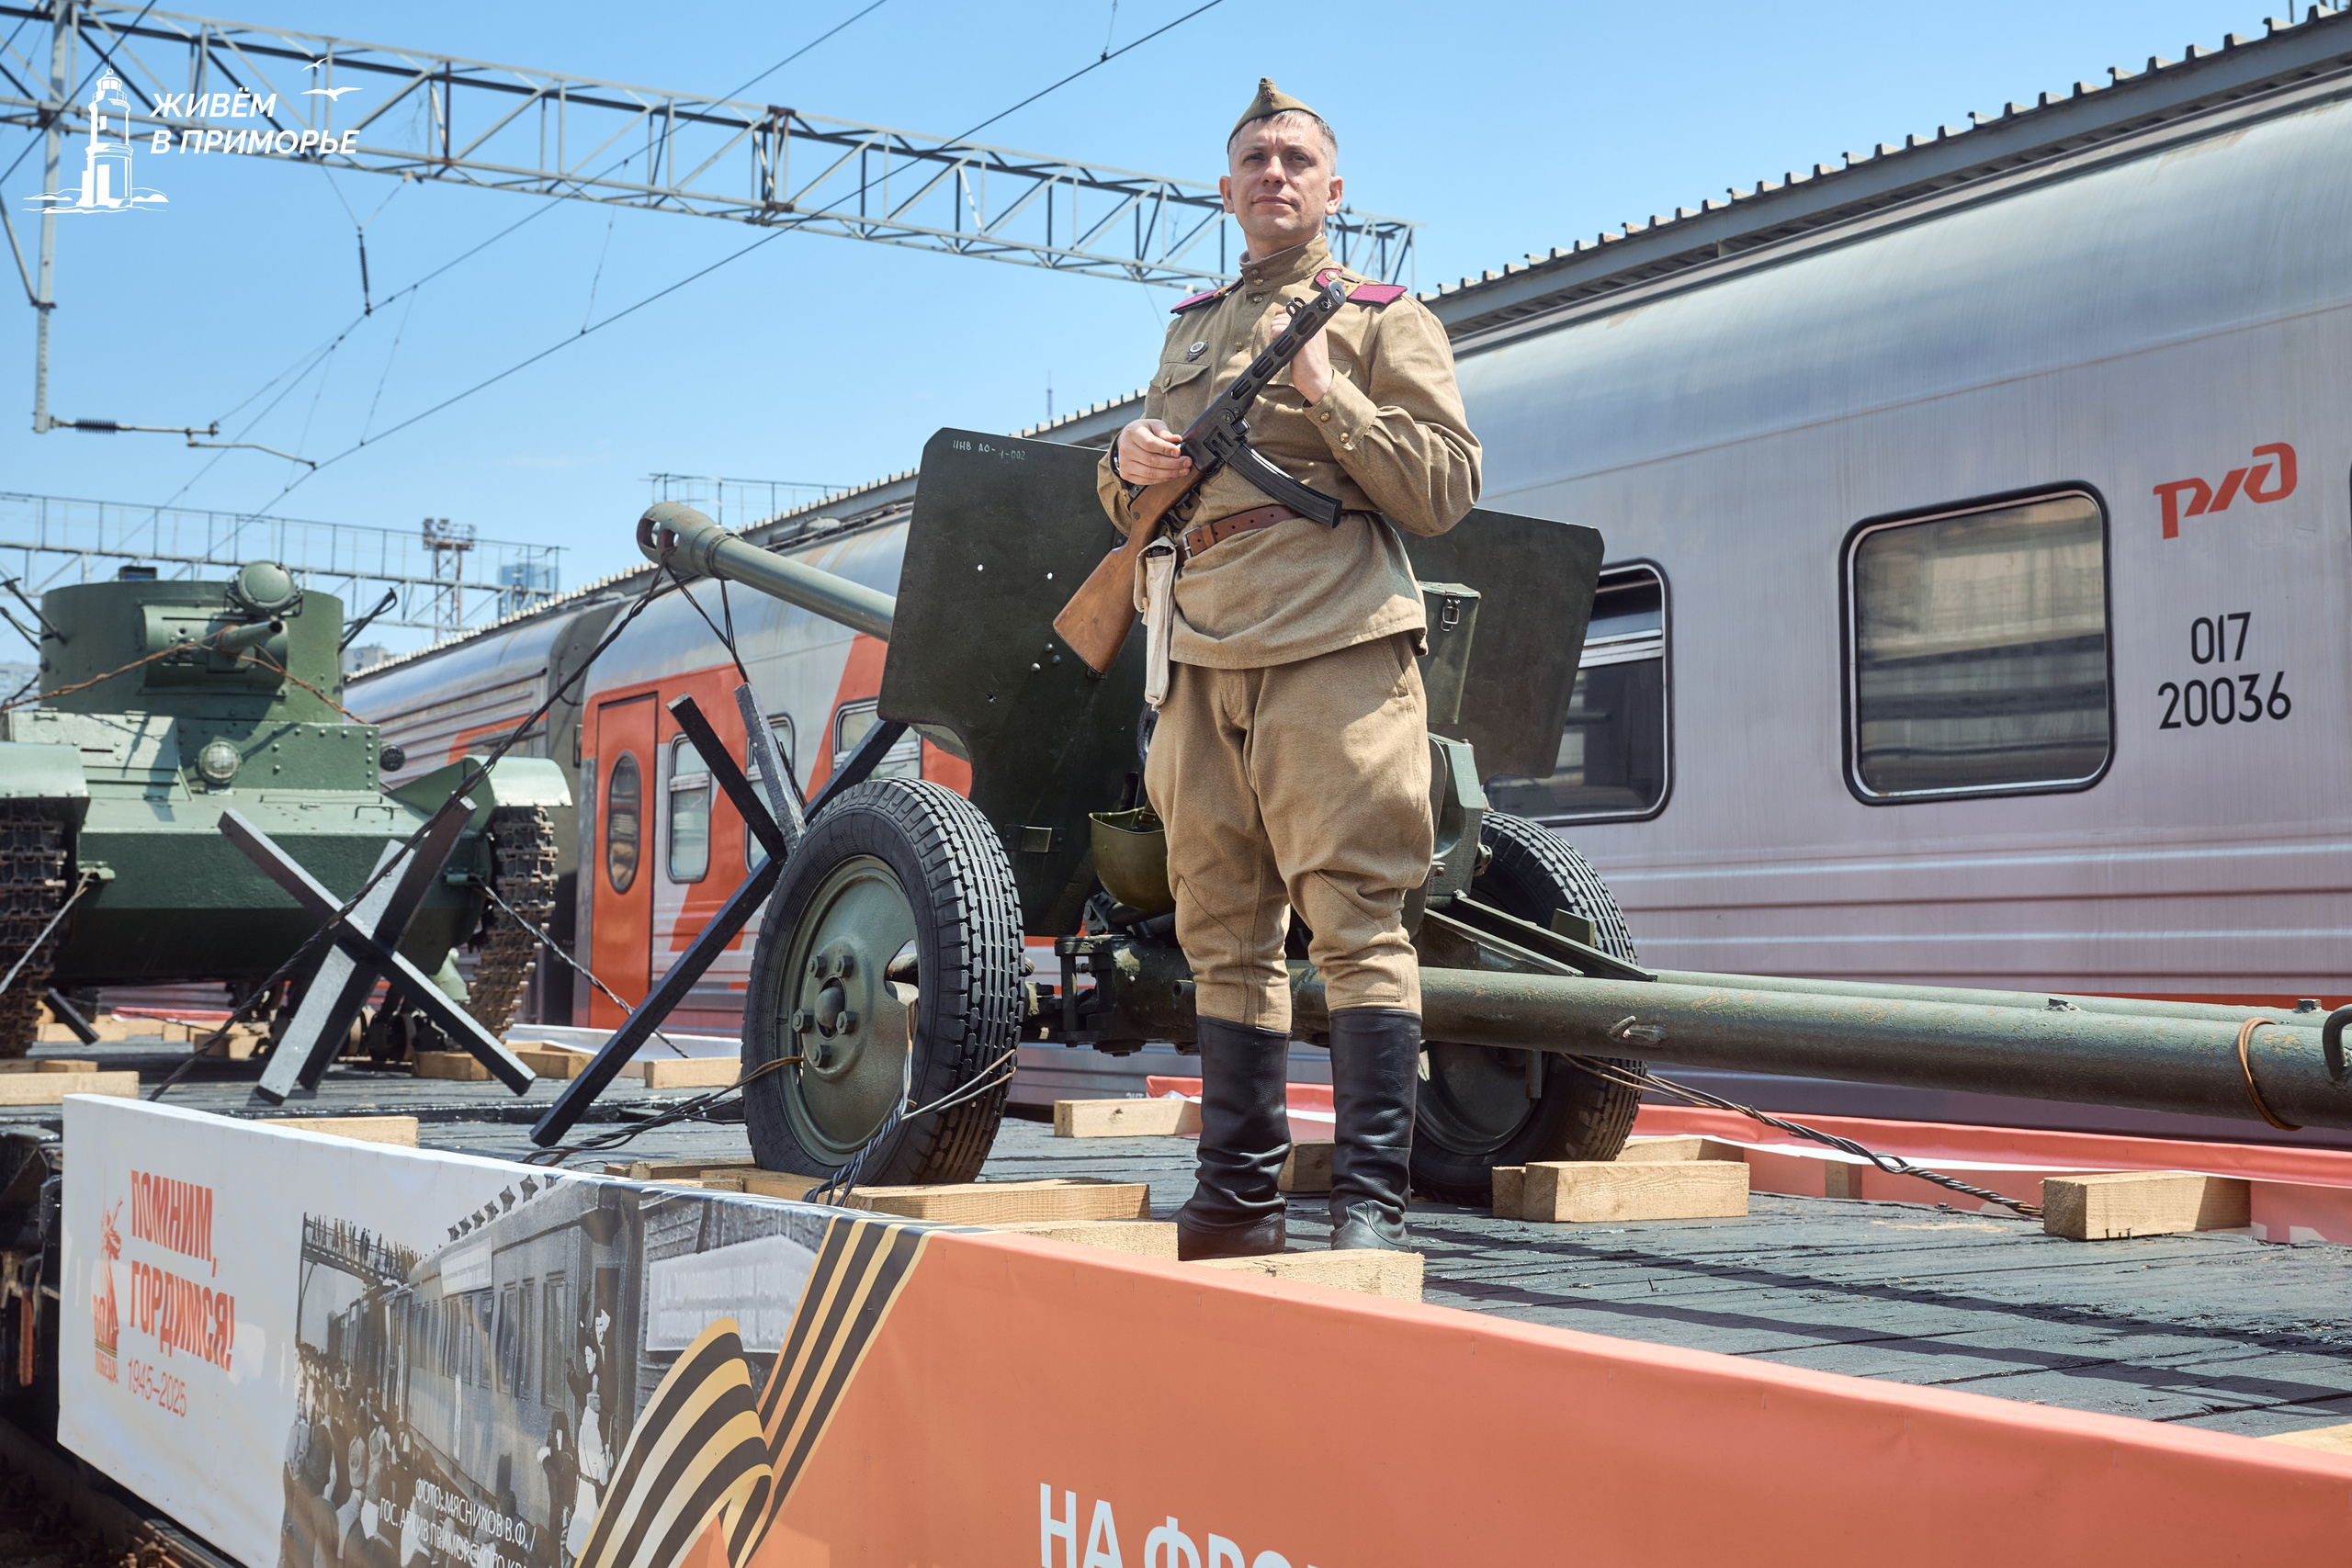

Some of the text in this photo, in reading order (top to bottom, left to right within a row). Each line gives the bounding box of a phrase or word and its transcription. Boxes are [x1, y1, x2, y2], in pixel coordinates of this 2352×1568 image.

[2191, 612, 2251, 664] 017
[2157, 671, 2291, 729] 20036
[130, 1169, 217, 1277] ПОМНИМ,
[130, 1260, 235, 1371] ГОРДИМСЯ!
[379, 1497, 399, 1529] ГОС.
[399, 1507, 429, 1542] АРХИВ
[505, 1517, 527, 1550] В.Ф.
[1040, 1482, 1124, 1568] НА
